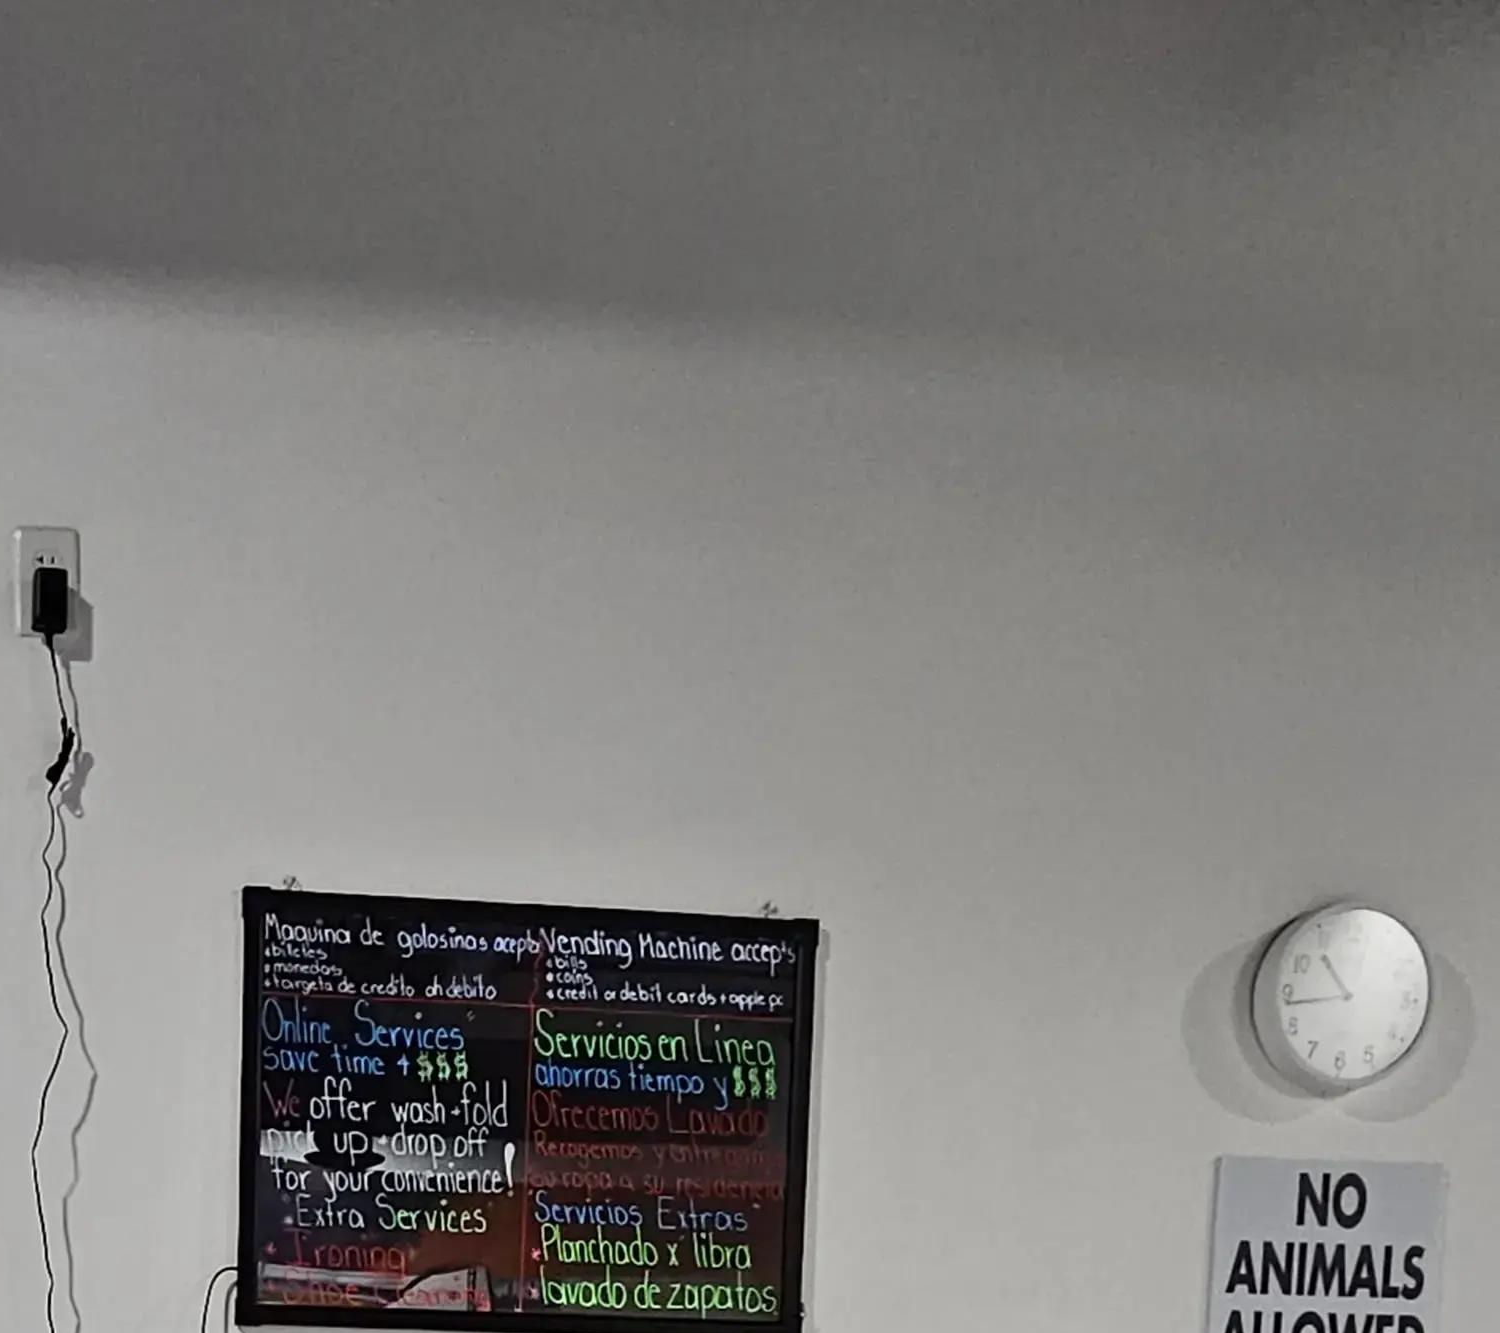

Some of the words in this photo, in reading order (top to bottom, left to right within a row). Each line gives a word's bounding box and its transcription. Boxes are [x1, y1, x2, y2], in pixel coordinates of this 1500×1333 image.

[360, 916, 385, 946] de
[397, 922, 488, 958] golosinas
[540, 927, 632, 969] Vending
[639, 932, 724, 961] Machine
[274, 960, 343, 977] monedas
[554, 955, 588, 971] bills
[556, 971, 593, 985] coins
[1293, 953, 1311, 974] 10
[338, 976, 357, 994] de
[667, 983, 717, 1006] cards
[261, 997, 332, 1044] Online
[354, 999, 465, 1050] Services
[533, 1008, 650, 1061] Servicios
[657, 1036, 688, 1062] en
[694, 1018, 776, 1066] Linea
[263, 1047, 319, 1073] save
[331, 1044, 386, 1075] time
[1307, 1040, 1319, 1060] 7
[263, 1078, 300, 1118] We
[310, 1075, 376, 1122] offer
[391, 1084, 445, 1125] wash
[460, 1078, 509, 1127] fold
[534, 1058, 621, 1089] ahorras
[629, 1061, 705, 1104] tiempo
[713, 1076, 729, 1110] y
[530, 1089, 659, 1132] Ofrecemos
[666, 1094, 769, 1138] Lavado
[267, 1120, 321, 1165] pick
[333, 1130, 368, 1167] up
[391, 1123, 446, 1169] drop
[453, 1127, 490, 1158] off
[271, 1155, 313, 1190] for
[323, 1168, 377, 1203] your
[381, 1142, 516, 1197] convenience!
[295, 1193, 365, 1228] Extra
[375, 1193, 488, 1233] Services
[534, 1189, 643, 1227] Servicios
[657, 1195, 749, 1232] Extras
[1296, 1172, 1367, 1229] NO
[540, 1222, 658, 1266] Planchado
[666, 1241, 680, 1267] x
[692, 1231, 752, 1270] libra
[539, 1264, 628, 1310] lavado
[634, 1269, 661, 1310] de
[1226, 1240, 1425, 1301] ANIMALS
